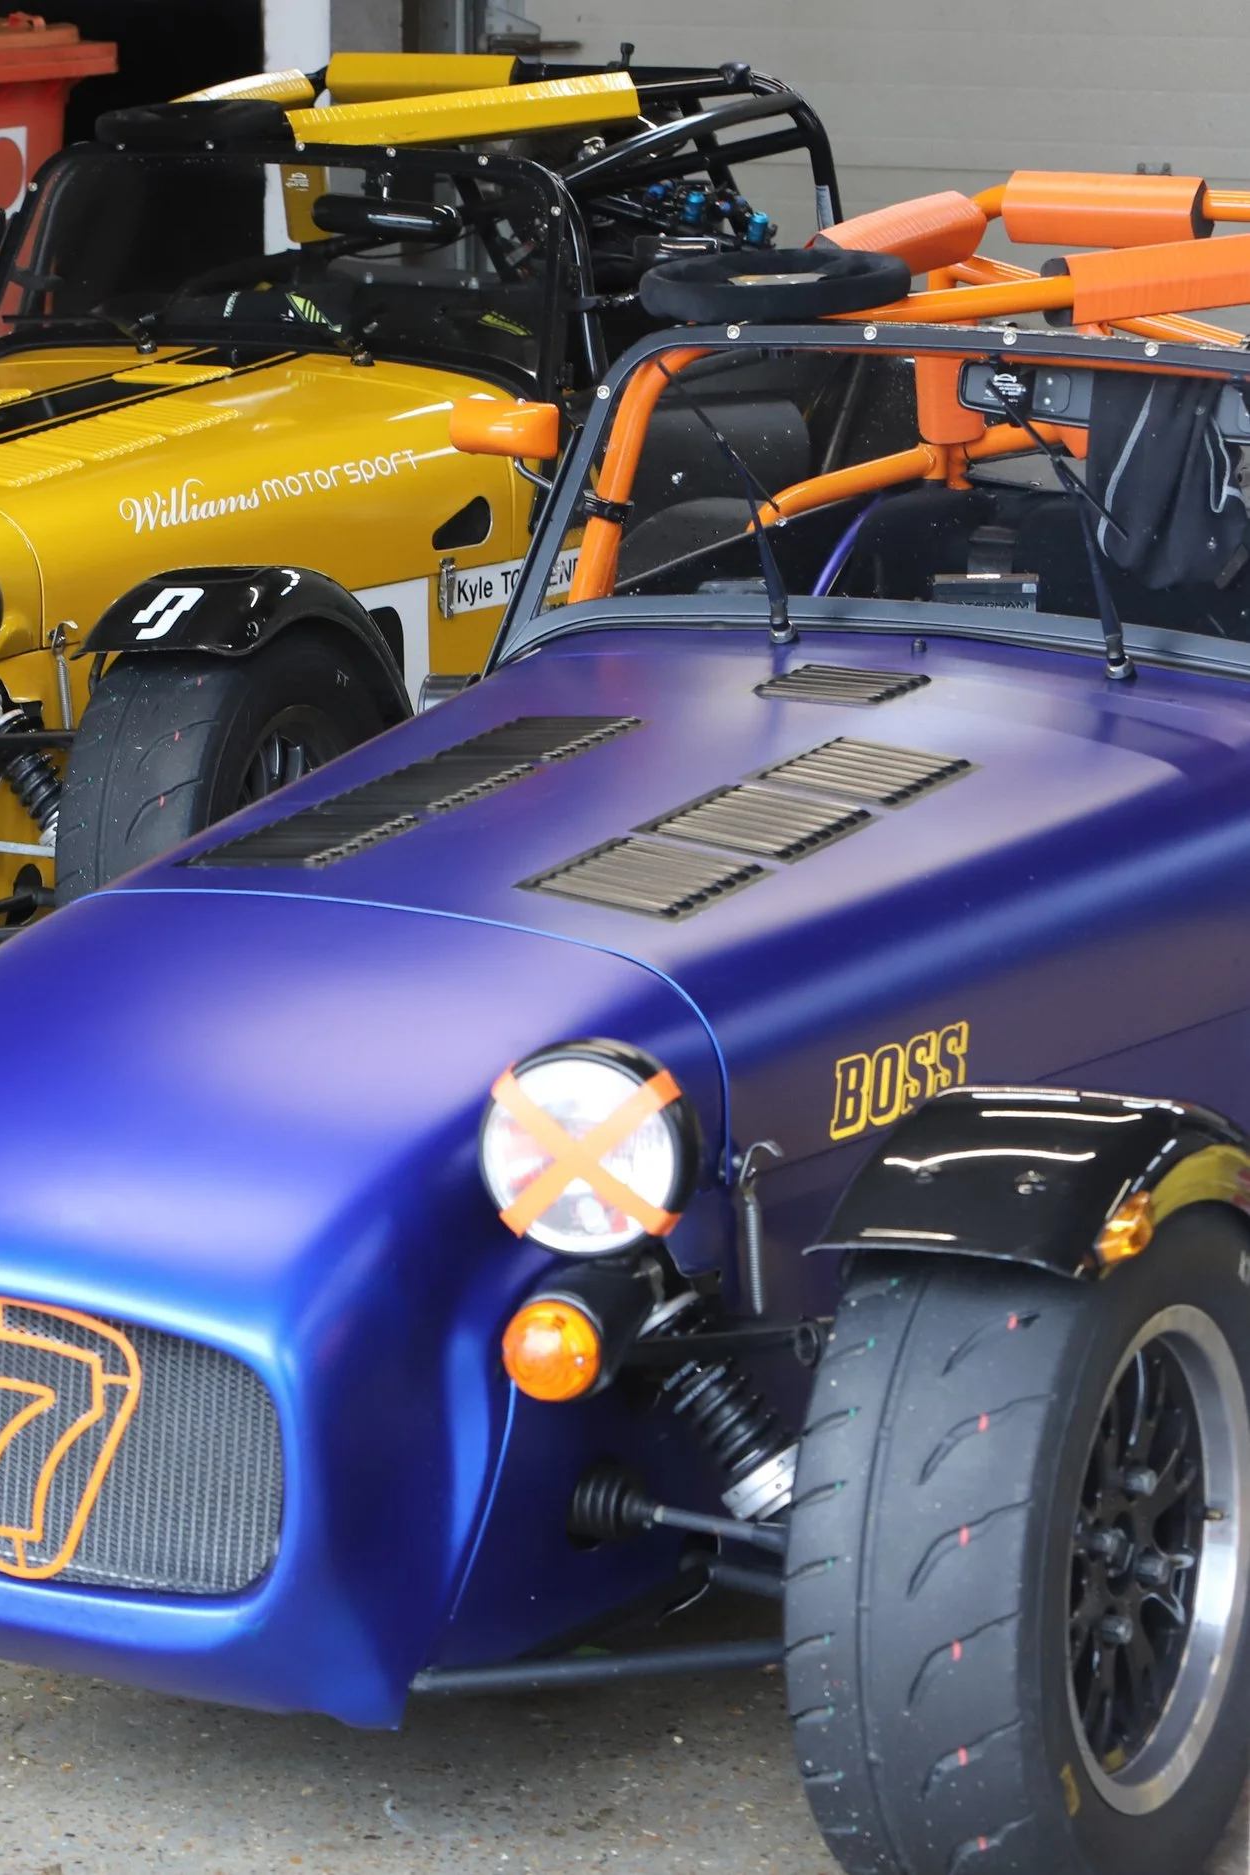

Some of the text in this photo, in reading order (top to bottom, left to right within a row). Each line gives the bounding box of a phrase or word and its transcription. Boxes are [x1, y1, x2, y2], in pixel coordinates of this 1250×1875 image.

[119, 478, 260, 534] Williams
[457, 575, 493, 606] Kyle
[829, 1020, 970, 1141] BOSS
